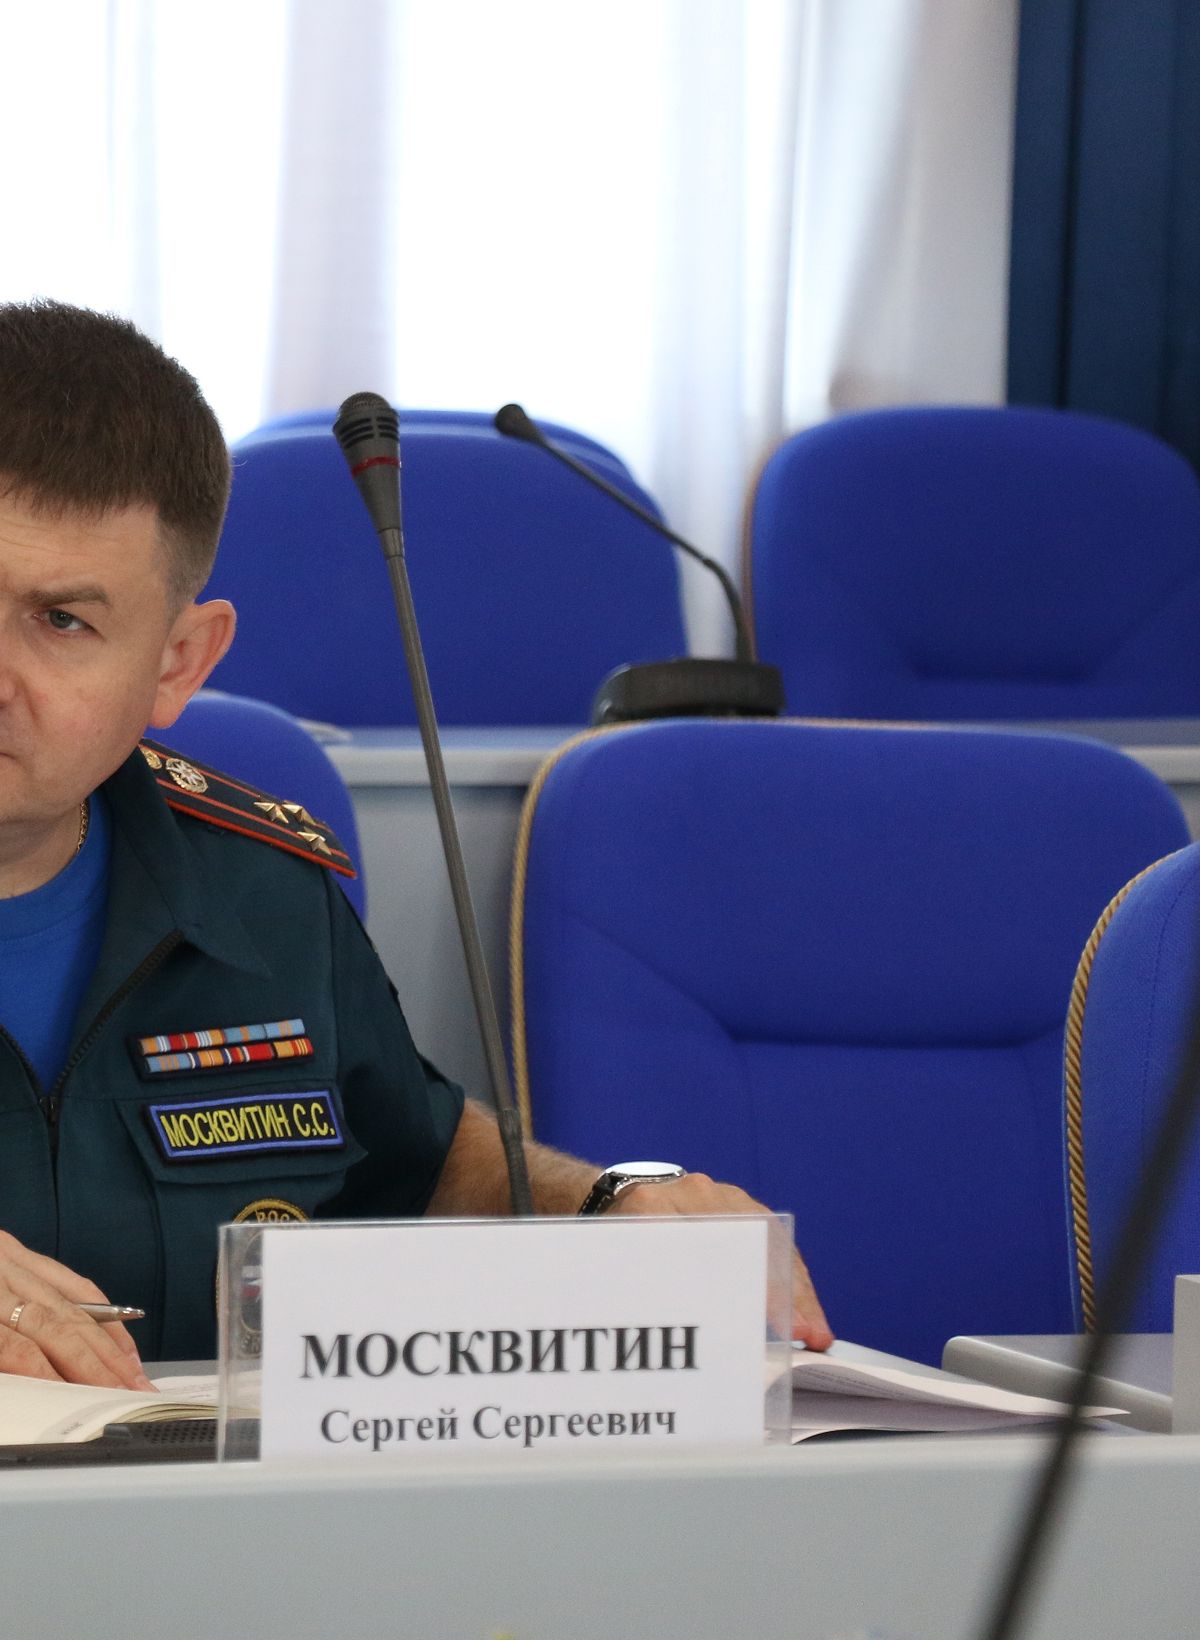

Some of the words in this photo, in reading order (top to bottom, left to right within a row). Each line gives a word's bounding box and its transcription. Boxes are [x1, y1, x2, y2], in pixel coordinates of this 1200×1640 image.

[160, 1104, 292, 1148] МОСКВИТИН
[293, 1102, 336, 1138] С.С.
[299, 1325, 700, 1379] МОСКВИТИН
[320, 1407, 458, 1452] Сергей
[472, 1404, 678, 1448] Сергеевич
